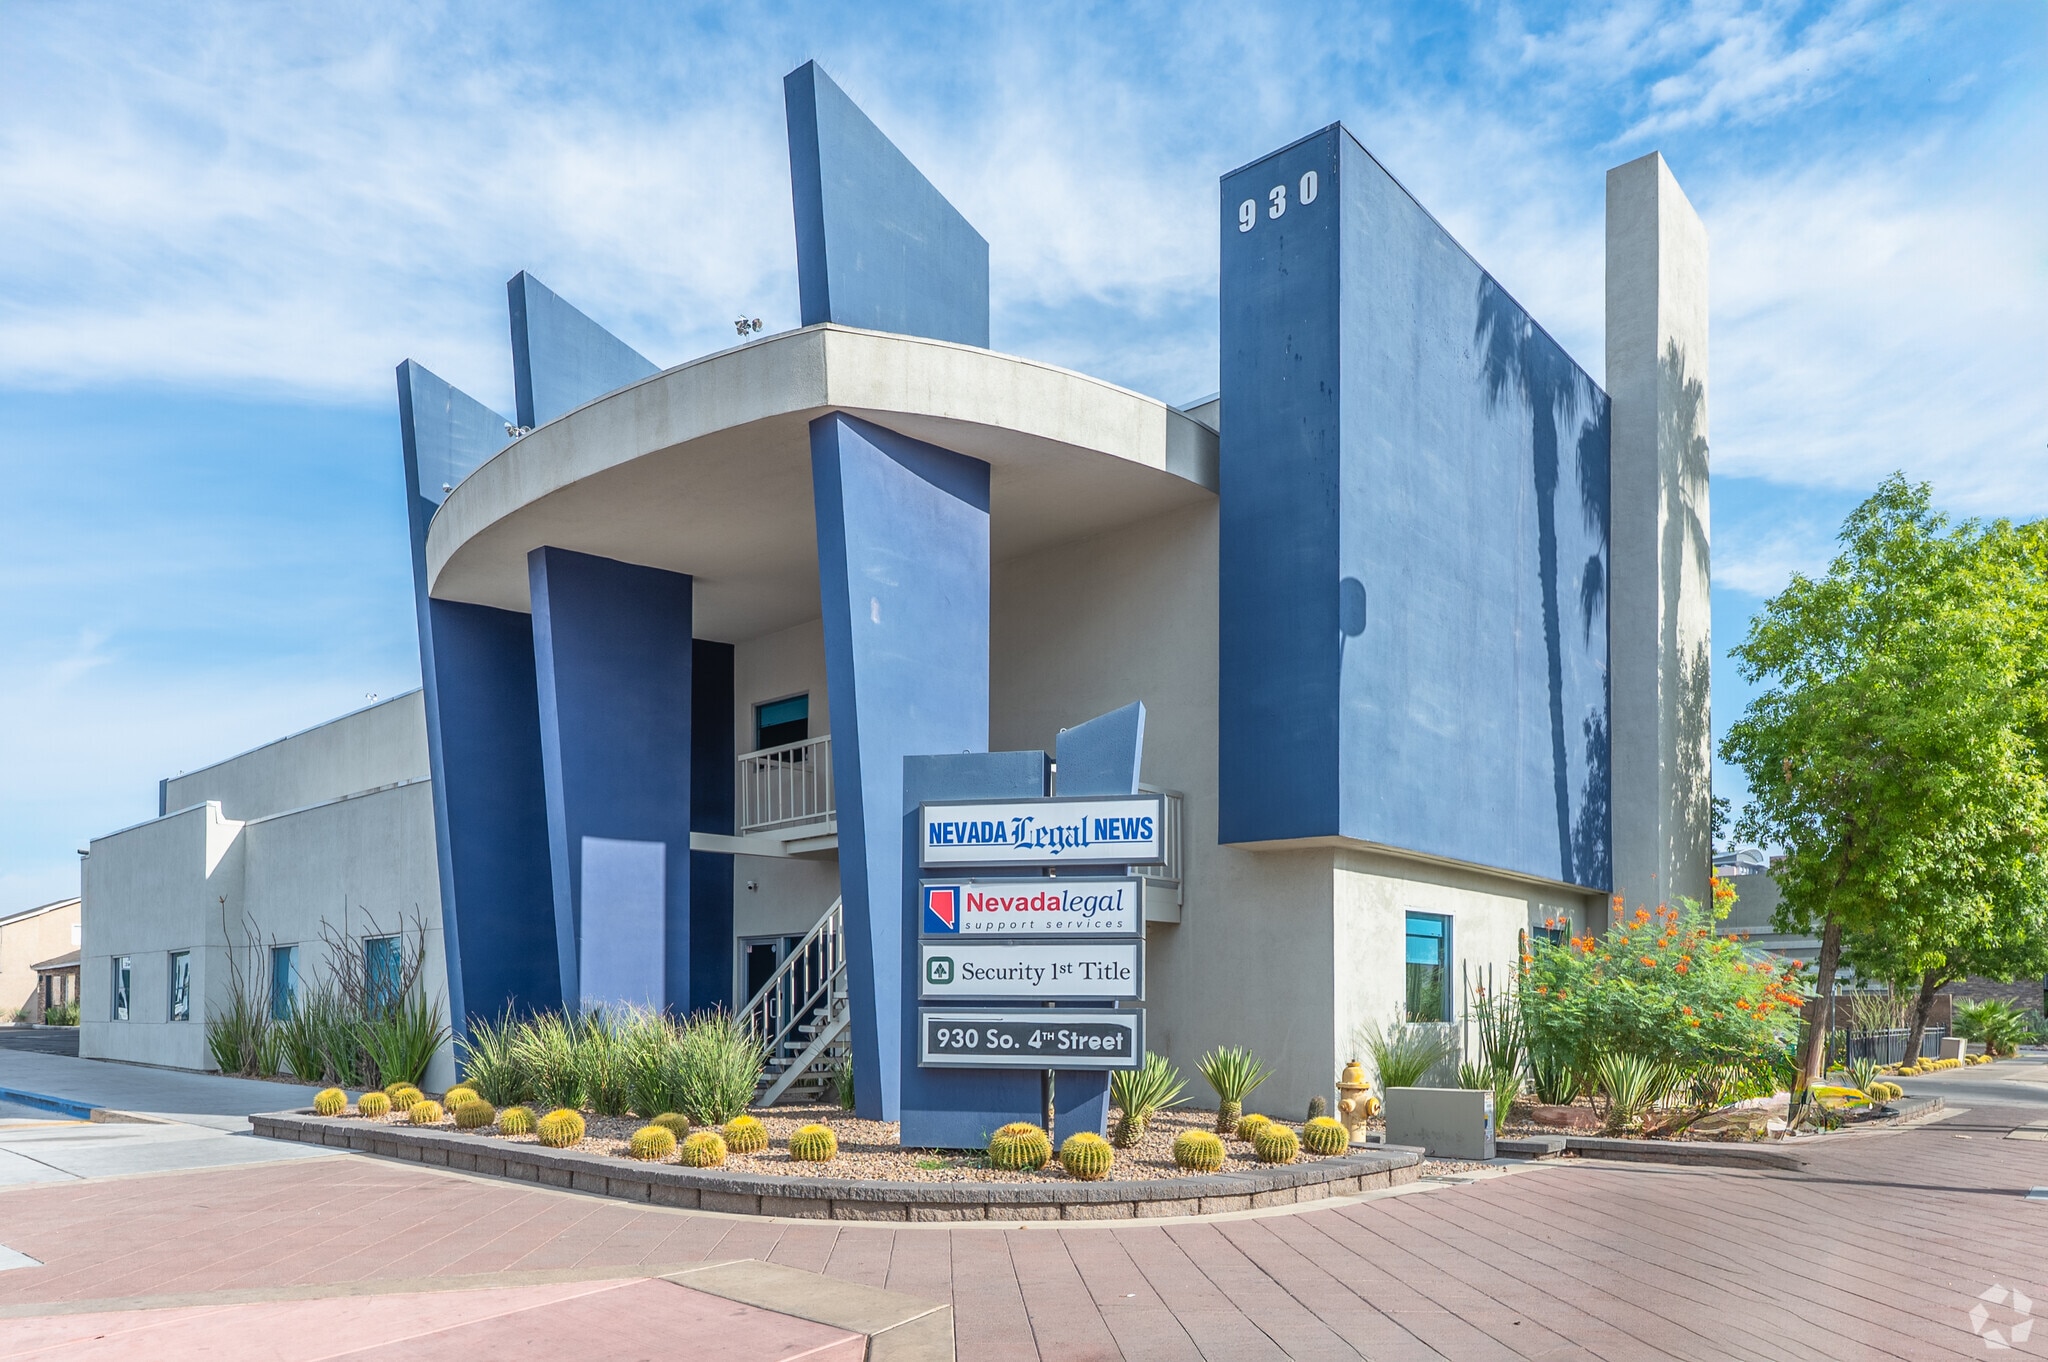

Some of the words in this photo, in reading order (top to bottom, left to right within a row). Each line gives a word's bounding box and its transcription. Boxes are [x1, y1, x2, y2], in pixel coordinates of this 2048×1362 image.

[1239, 170, 1318, 233] 930
[929, 821, 1007, 844] NEVADA
[1011, 815, 1091, 855] Legal
[1094, 816, 1153, 841] NEWS
[965, 920, 1035, 931] support
[1046, 919, 1123, 930] services
[962, 962, 1046, 986] Security
[1051, 962, 1073, 980] 1st
[1079, 961, 1131, 981] Title
[937, 1028, 979, 1049] 930
[986, 1029, 1020, 1049] So.
[1028, 1029, 1055, 1049] 4TH
[1057, 1029, 1124, 1050] Street
